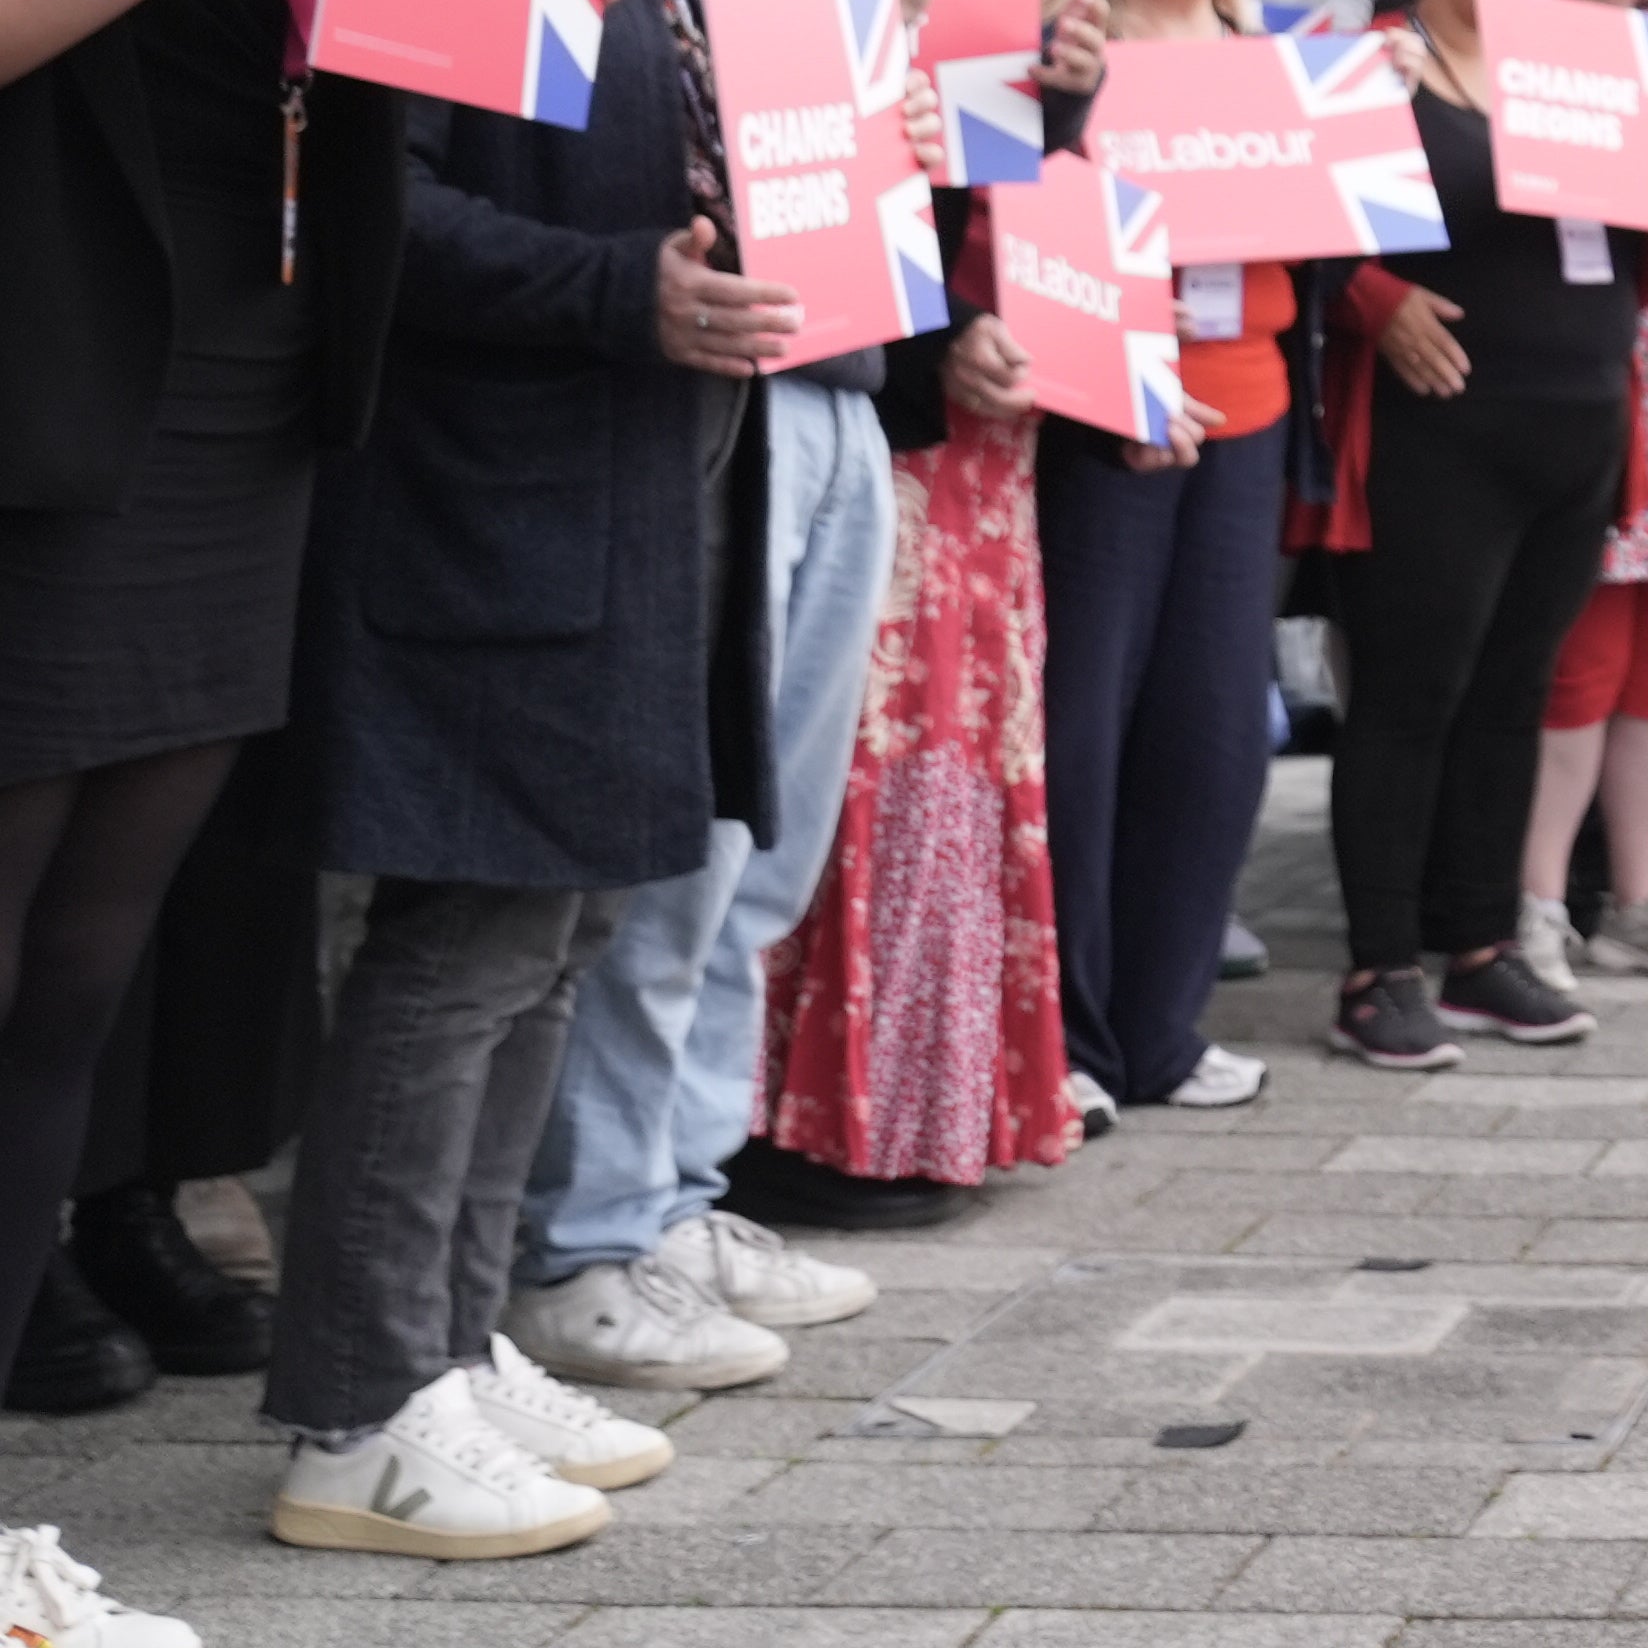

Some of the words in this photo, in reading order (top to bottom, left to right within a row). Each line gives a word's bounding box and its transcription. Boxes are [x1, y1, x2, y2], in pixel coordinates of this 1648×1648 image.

[1498, 57, 1640, 116] CHANGE
[738, 103, 858, 171] CHANGE
[1145, 127, 1315, 173] Labour
[1505, 97, 1624, 152] BEGINS
[749, 168, 851, 240] BEGINS
[1021, 239, 1122, 324] Labour
